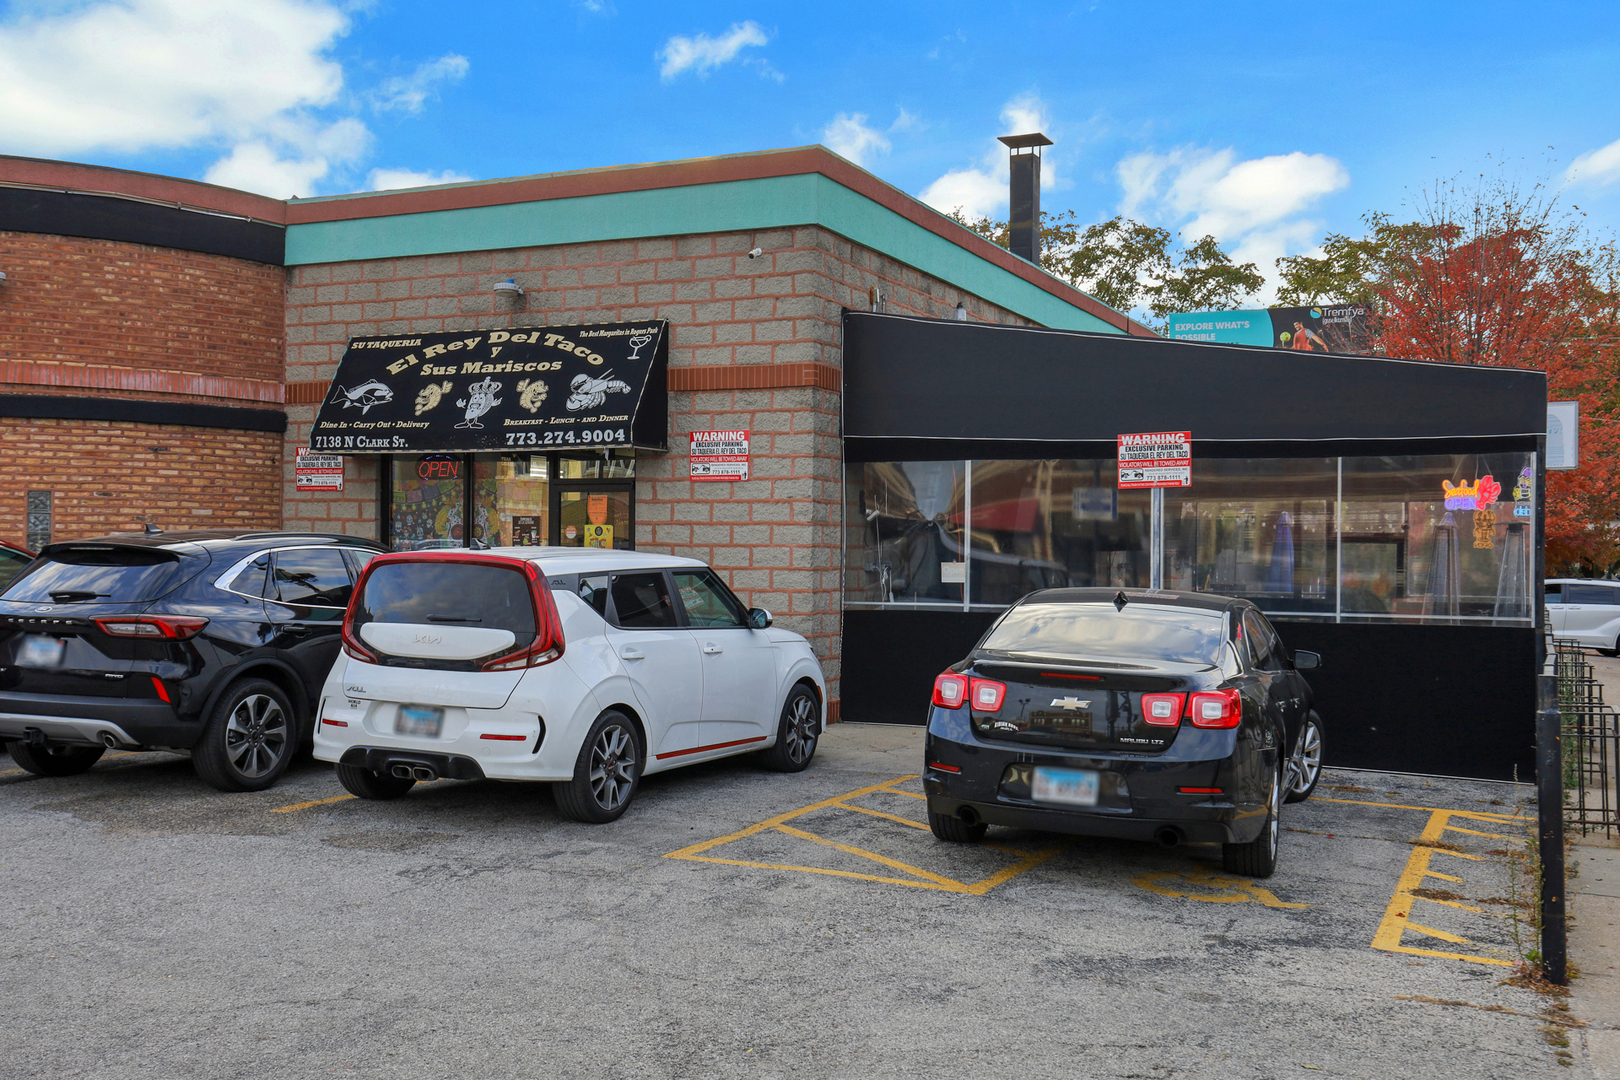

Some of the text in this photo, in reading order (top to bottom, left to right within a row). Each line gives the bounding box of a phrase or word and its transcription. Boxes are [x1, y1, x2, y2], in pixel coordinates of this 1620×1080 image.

[1322, 306, 1364, 318] Tremfya
[579, 330, 588, 338] The
[599, 329, 624, 338] Margaritas
[630, 327, 647, 336] Rogers
[646, 326, 659, 334] Park
[1175, 321, 1250, 331] EXPLORE WHAT'S
[1175, 333, 1216, 341] POSSIBLE
[367, 338, 422, 349] TAQUERIA
[386, 331, 604, 376] El Rey Del Taco
[420, 360, 562, 376] Sus Mariscos
[353, 421, 376, 430] Carry
[395, 420, 430, 430] Delivery
[315, 436, 342, 448] 7138
[343, 436, 355, 448] N
[505, 428, 625, 446] 773.274.9004
[692, 431, 745, 441] WARNING
[1121, 433, 1185, 445] WARNING
[1127, 452, 1149, 460] TAQUERIA
[418, 461, 458, 477] OPEN
[1442, 479, 1480, 498] Seafood
[1445, 498, 1476, 510] OPEN
[943, 565, 964, 575] Open
